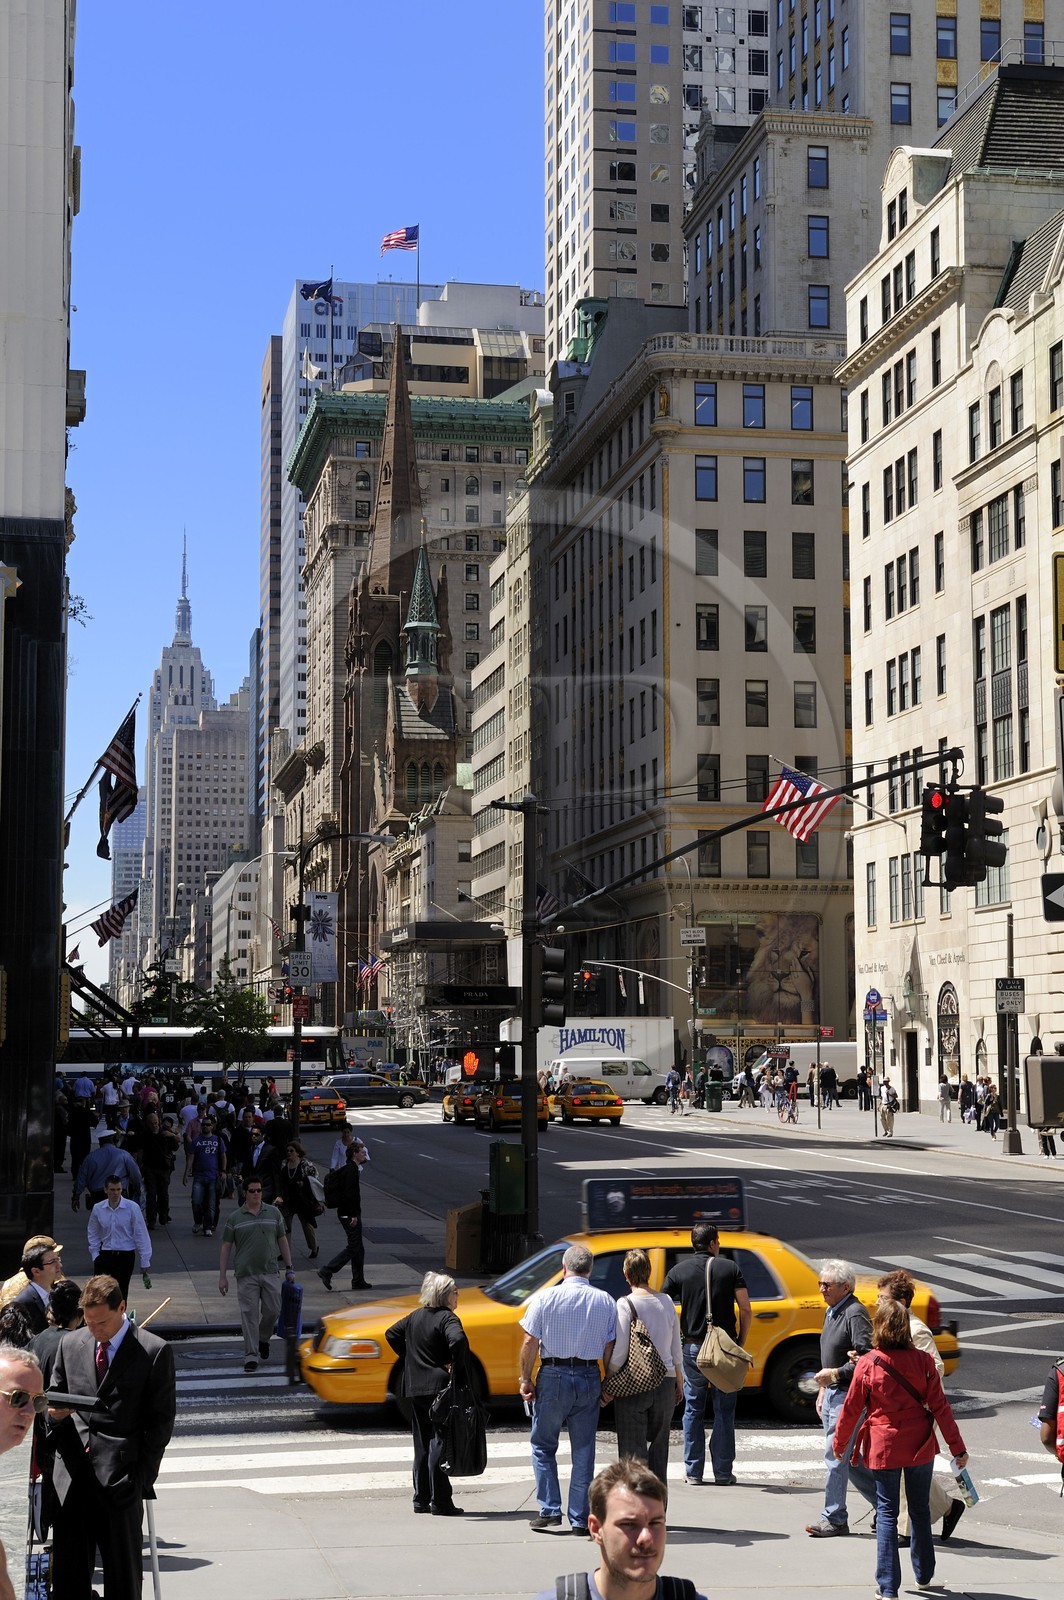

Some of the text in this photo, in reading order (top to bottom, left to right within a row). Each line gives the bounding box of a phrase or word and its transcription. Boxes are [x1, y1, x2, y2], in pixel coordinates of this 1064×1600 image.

[315, 301, 342, 316] citi
[937, 953, 947, 964] Cleef
[953, 952, 965, 965] Arpels
[291, 967, 309, 977] 30
[864, 963, 873, 973] Cleef
[559, 1028, 626, 1055] HAMILTON
[153, 1065, 193, 1075] PRIEST
